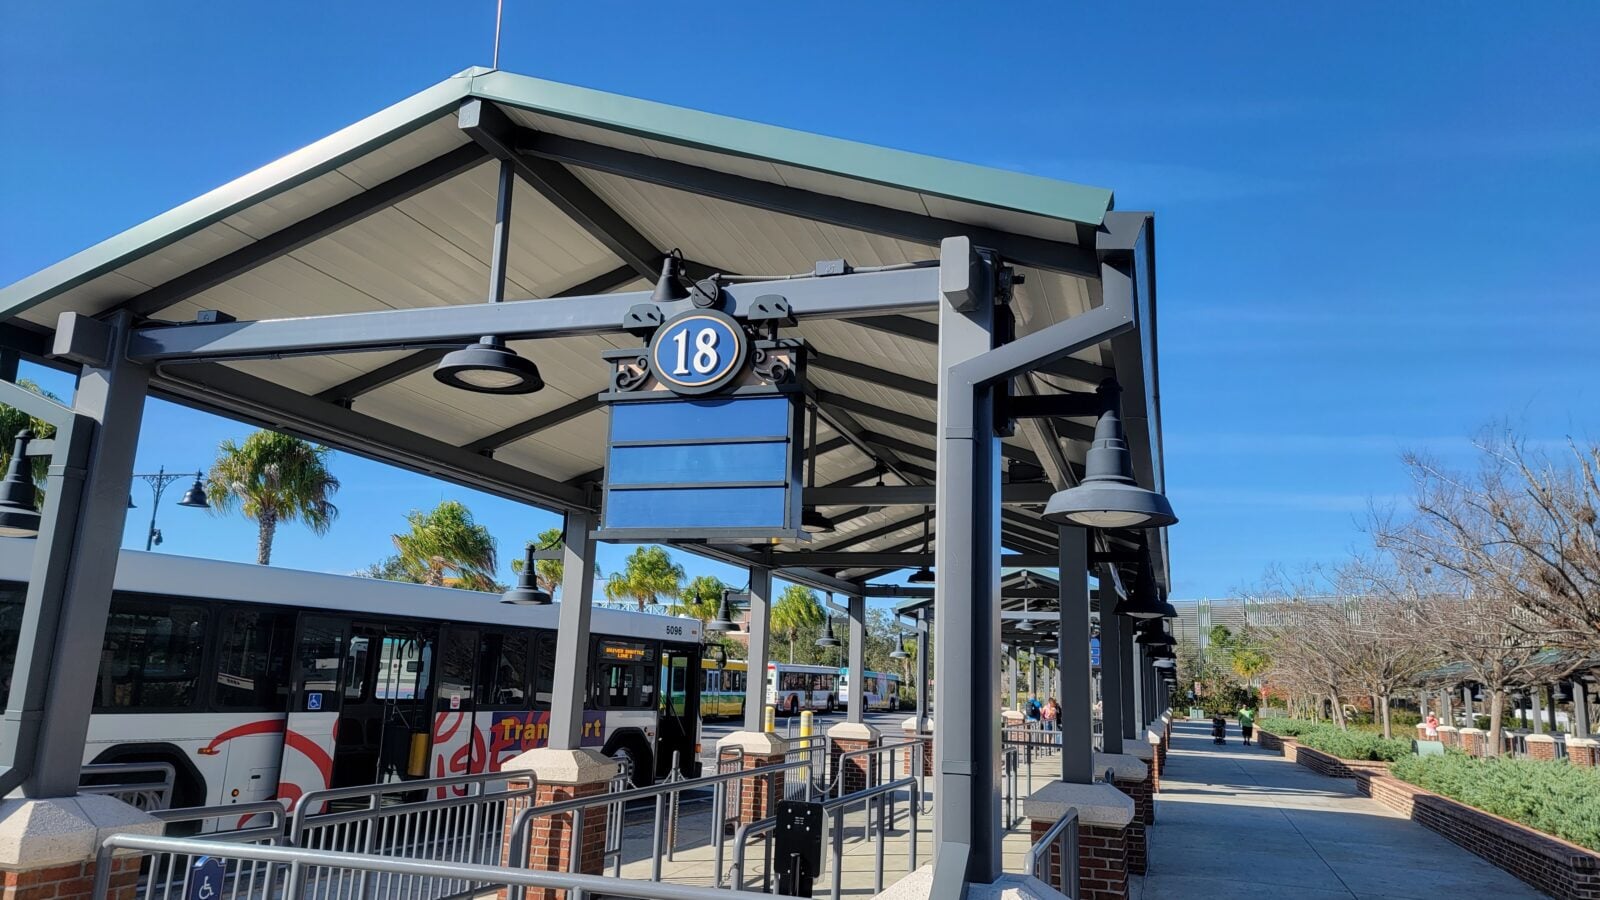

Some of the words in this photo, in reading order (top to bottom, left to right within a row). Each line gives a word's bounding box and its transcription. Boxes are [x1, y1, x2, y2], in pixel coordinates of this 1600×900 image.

[673, 327, 718, 375] 18
[666, 625, 683, 636] 5096
[501, 718, 601, 741] Tranrt
